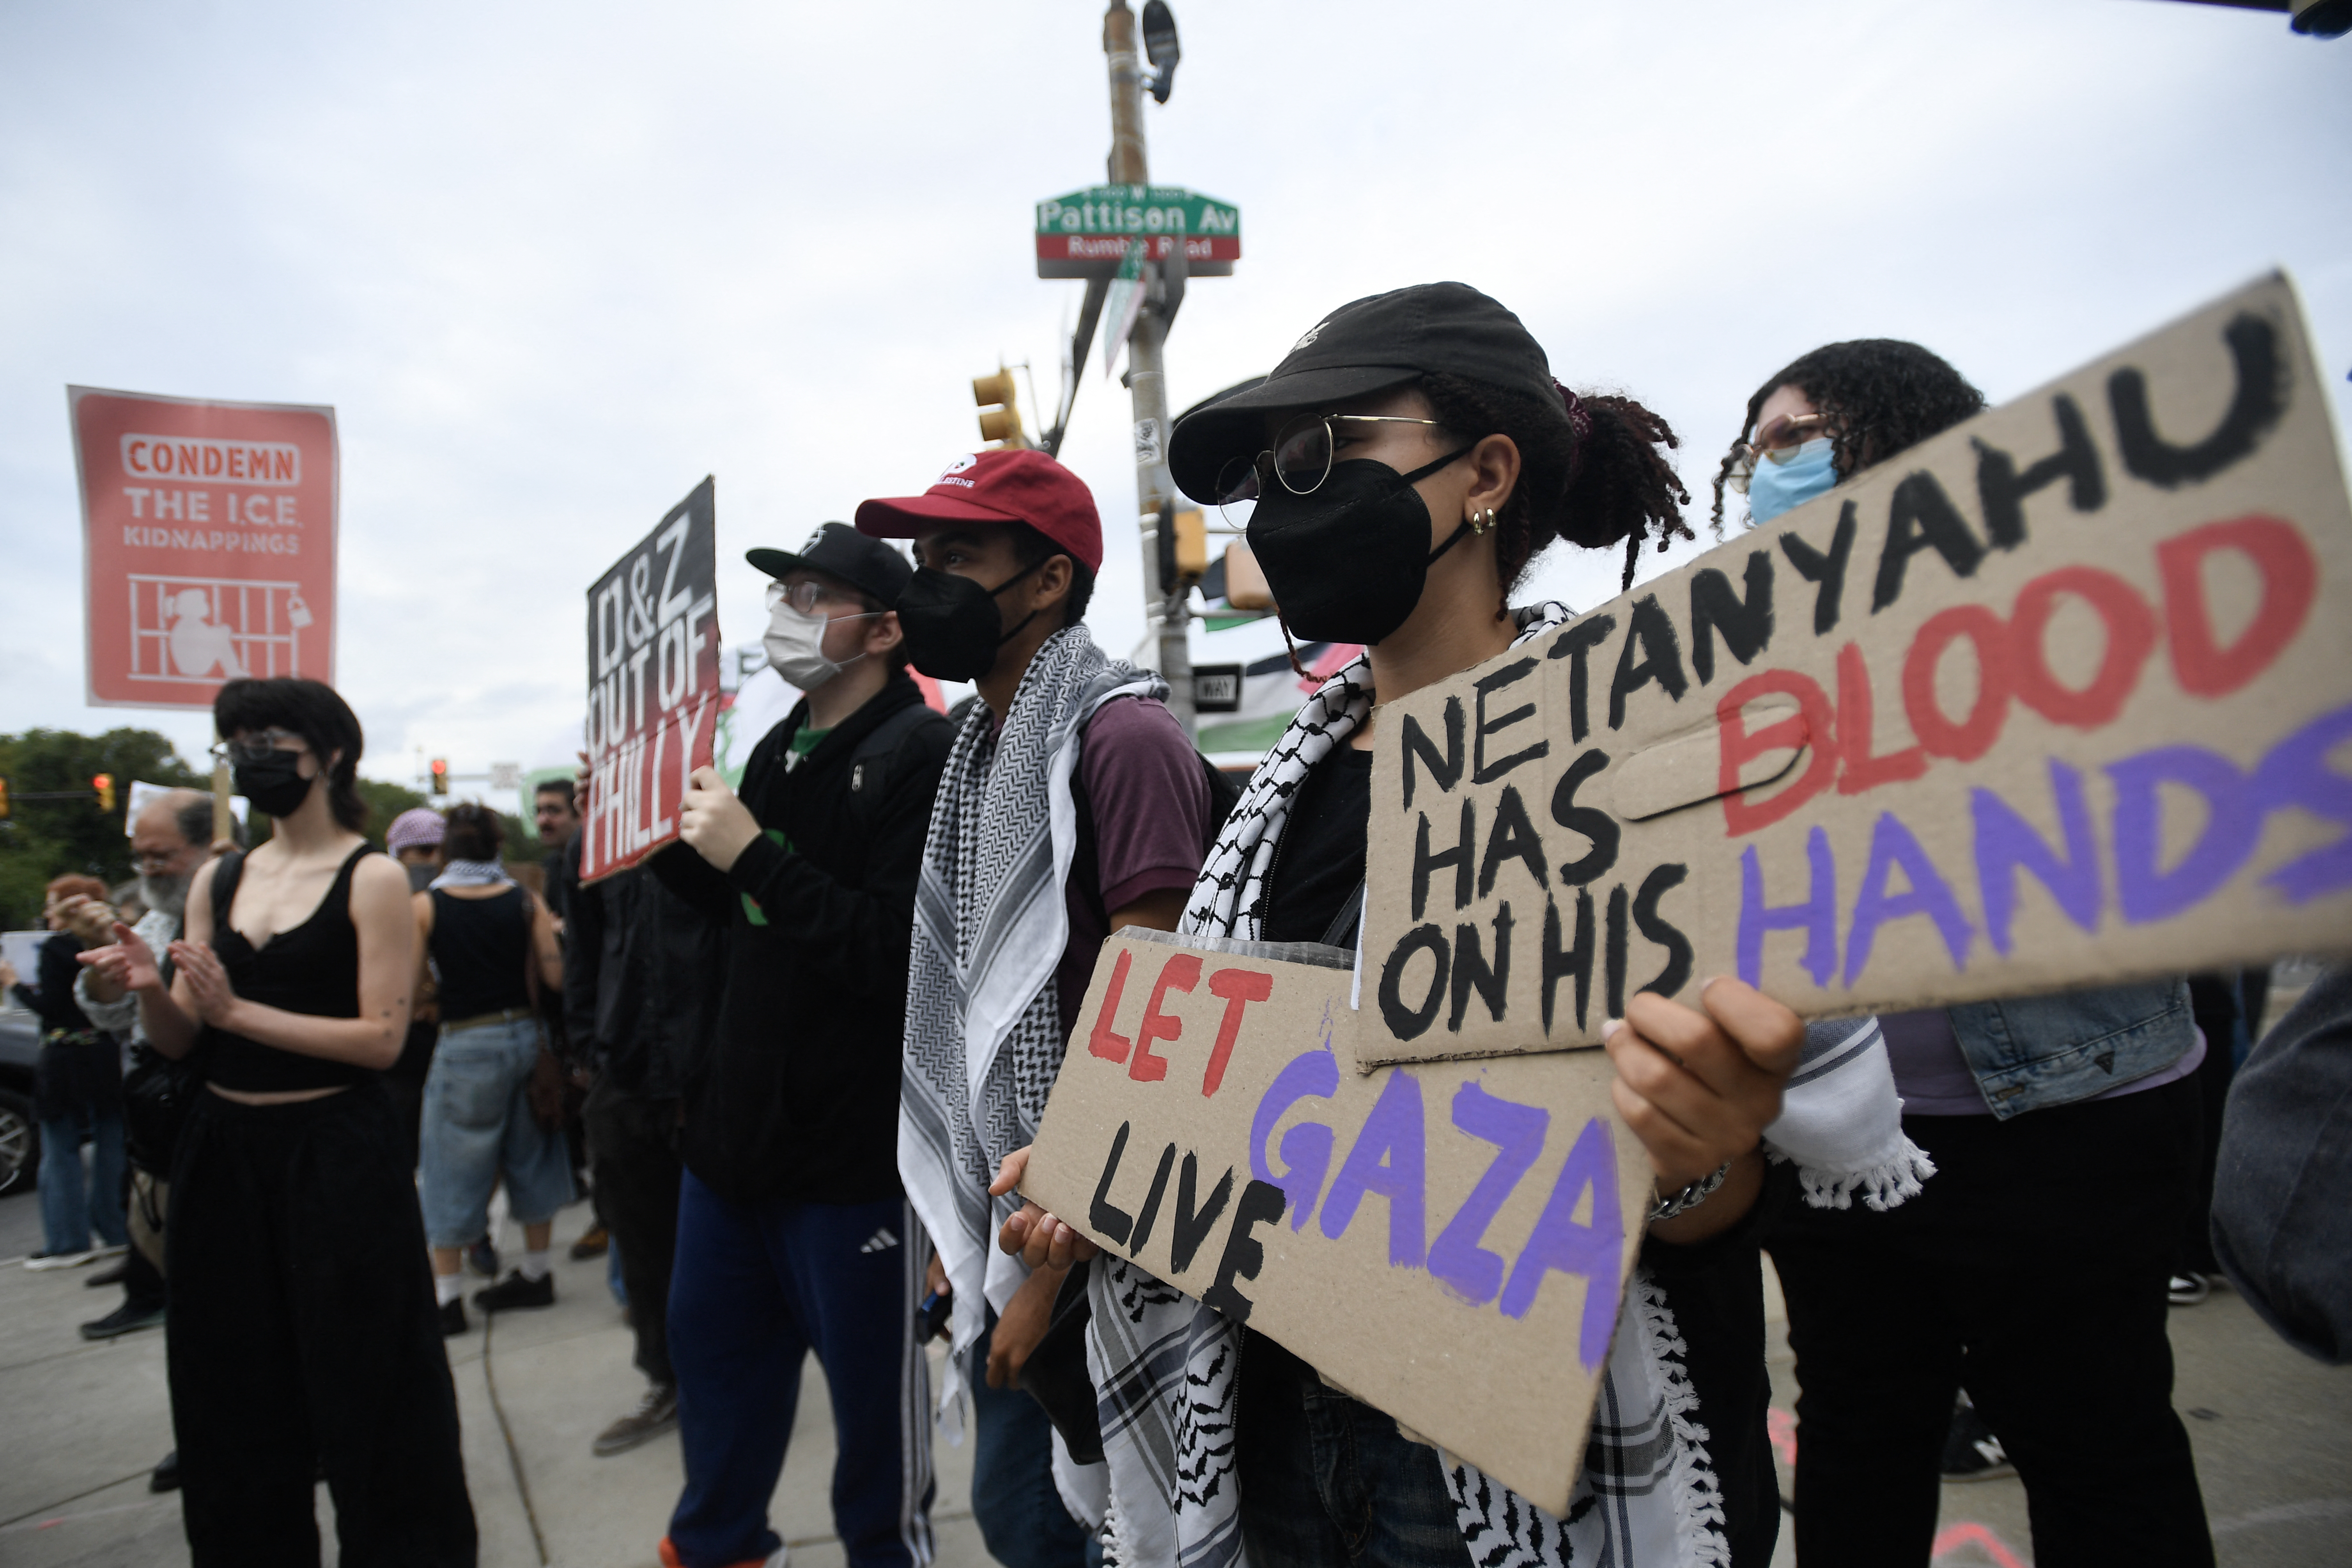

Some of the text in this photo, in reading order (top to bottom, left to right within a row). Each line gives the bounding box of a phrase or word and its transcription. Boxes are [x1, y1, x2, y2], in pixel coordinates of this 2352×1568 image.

[1040, 201, 1237, 233] Pattison Av
[1068, 236, 1213, 258] Rumbe Rad
[123, 487, 304, 529] THE I.C.E.
[123, 525, 300, 555] KIDNAPPINGS
[128, 440, 294, 481] CONDEMN
[597, 510, 691, 680] D&Z
[1402, 308, 2292, 813] NETANYAHU
[589, 594, 713, 761] OUT OF
[1716, 510, 2318, 837] BLOOD
[585, 691, 708, 877] PHILLY
[1412, 747, 1621, 921] HAS
[1736, 702, 2352, 991] HANDS
[1087, 948, 1273, 1098] LET
[1379, 862, 1694, 1041] ON HIS
[1088, 1121, 1286, 1321] LIVE
[1250, 1043, 1625, 1375] GAZA
